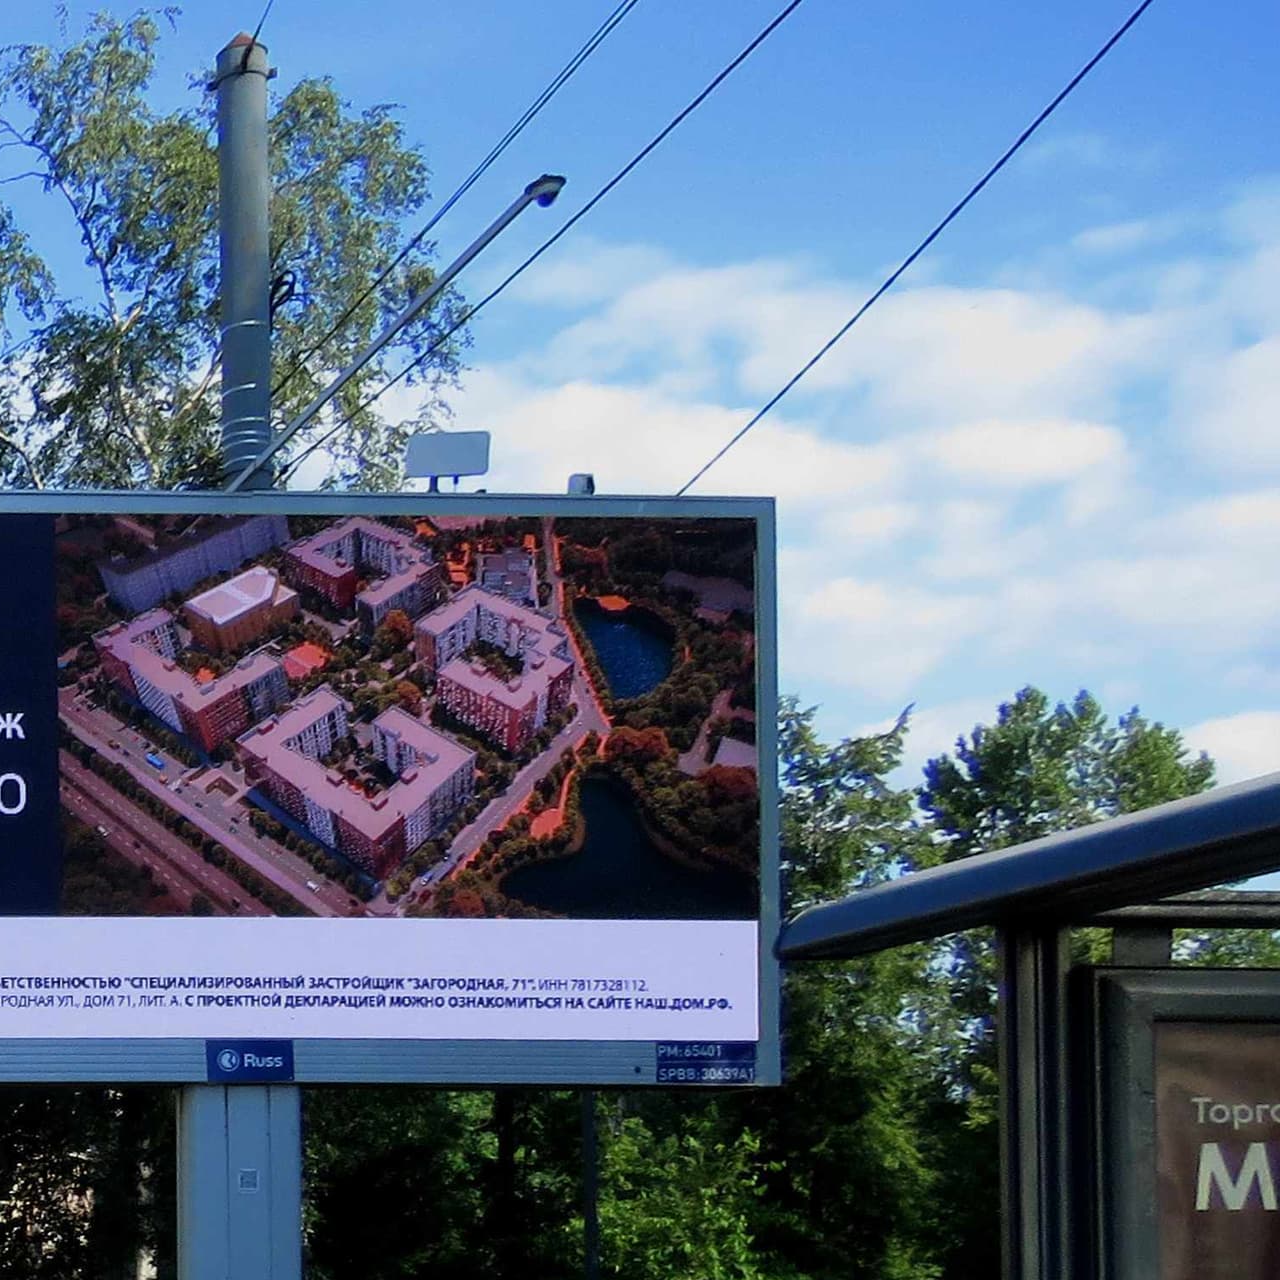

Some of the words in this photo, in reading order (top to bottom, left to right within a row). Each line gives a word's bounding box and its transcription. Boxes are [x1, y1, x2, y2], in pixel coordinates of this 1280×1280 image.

[125, 975, 305, 990] "СПЕЦИАЛИЗИРОВАННЫЙ
[309, 975, 405, 991] ЗАСТРОЙЩИК
[407, 977, 509, 991] "ЗАГОРОДНАЯ,
[539, 978, 568, 991] ИНН
[83, 996, 115, 1008] ДОМ
[118, 996, 137, 1008] 71,
[140, 996, 166, 1008] ЛИТ.
[185, 996, 194, 1007] С
[197, 993, 282, 1007] ПРОЕКТНОЙ
[284, 994, 386, 1009] ДЕКЛАРАЦИЕЙ
[390, 996, 445, 1008] МОЖНО
[448, 996, 561, 1009] ОЗНАКОМИТЬСЯ
[565, 997, 584, 1009] НА
[587, 995, 632, 1010] САЙТЕ
[635, 998, 733, 1011] НАШ.ДОМ.РФ.
[243, 1053, 284, 1068] Russ
